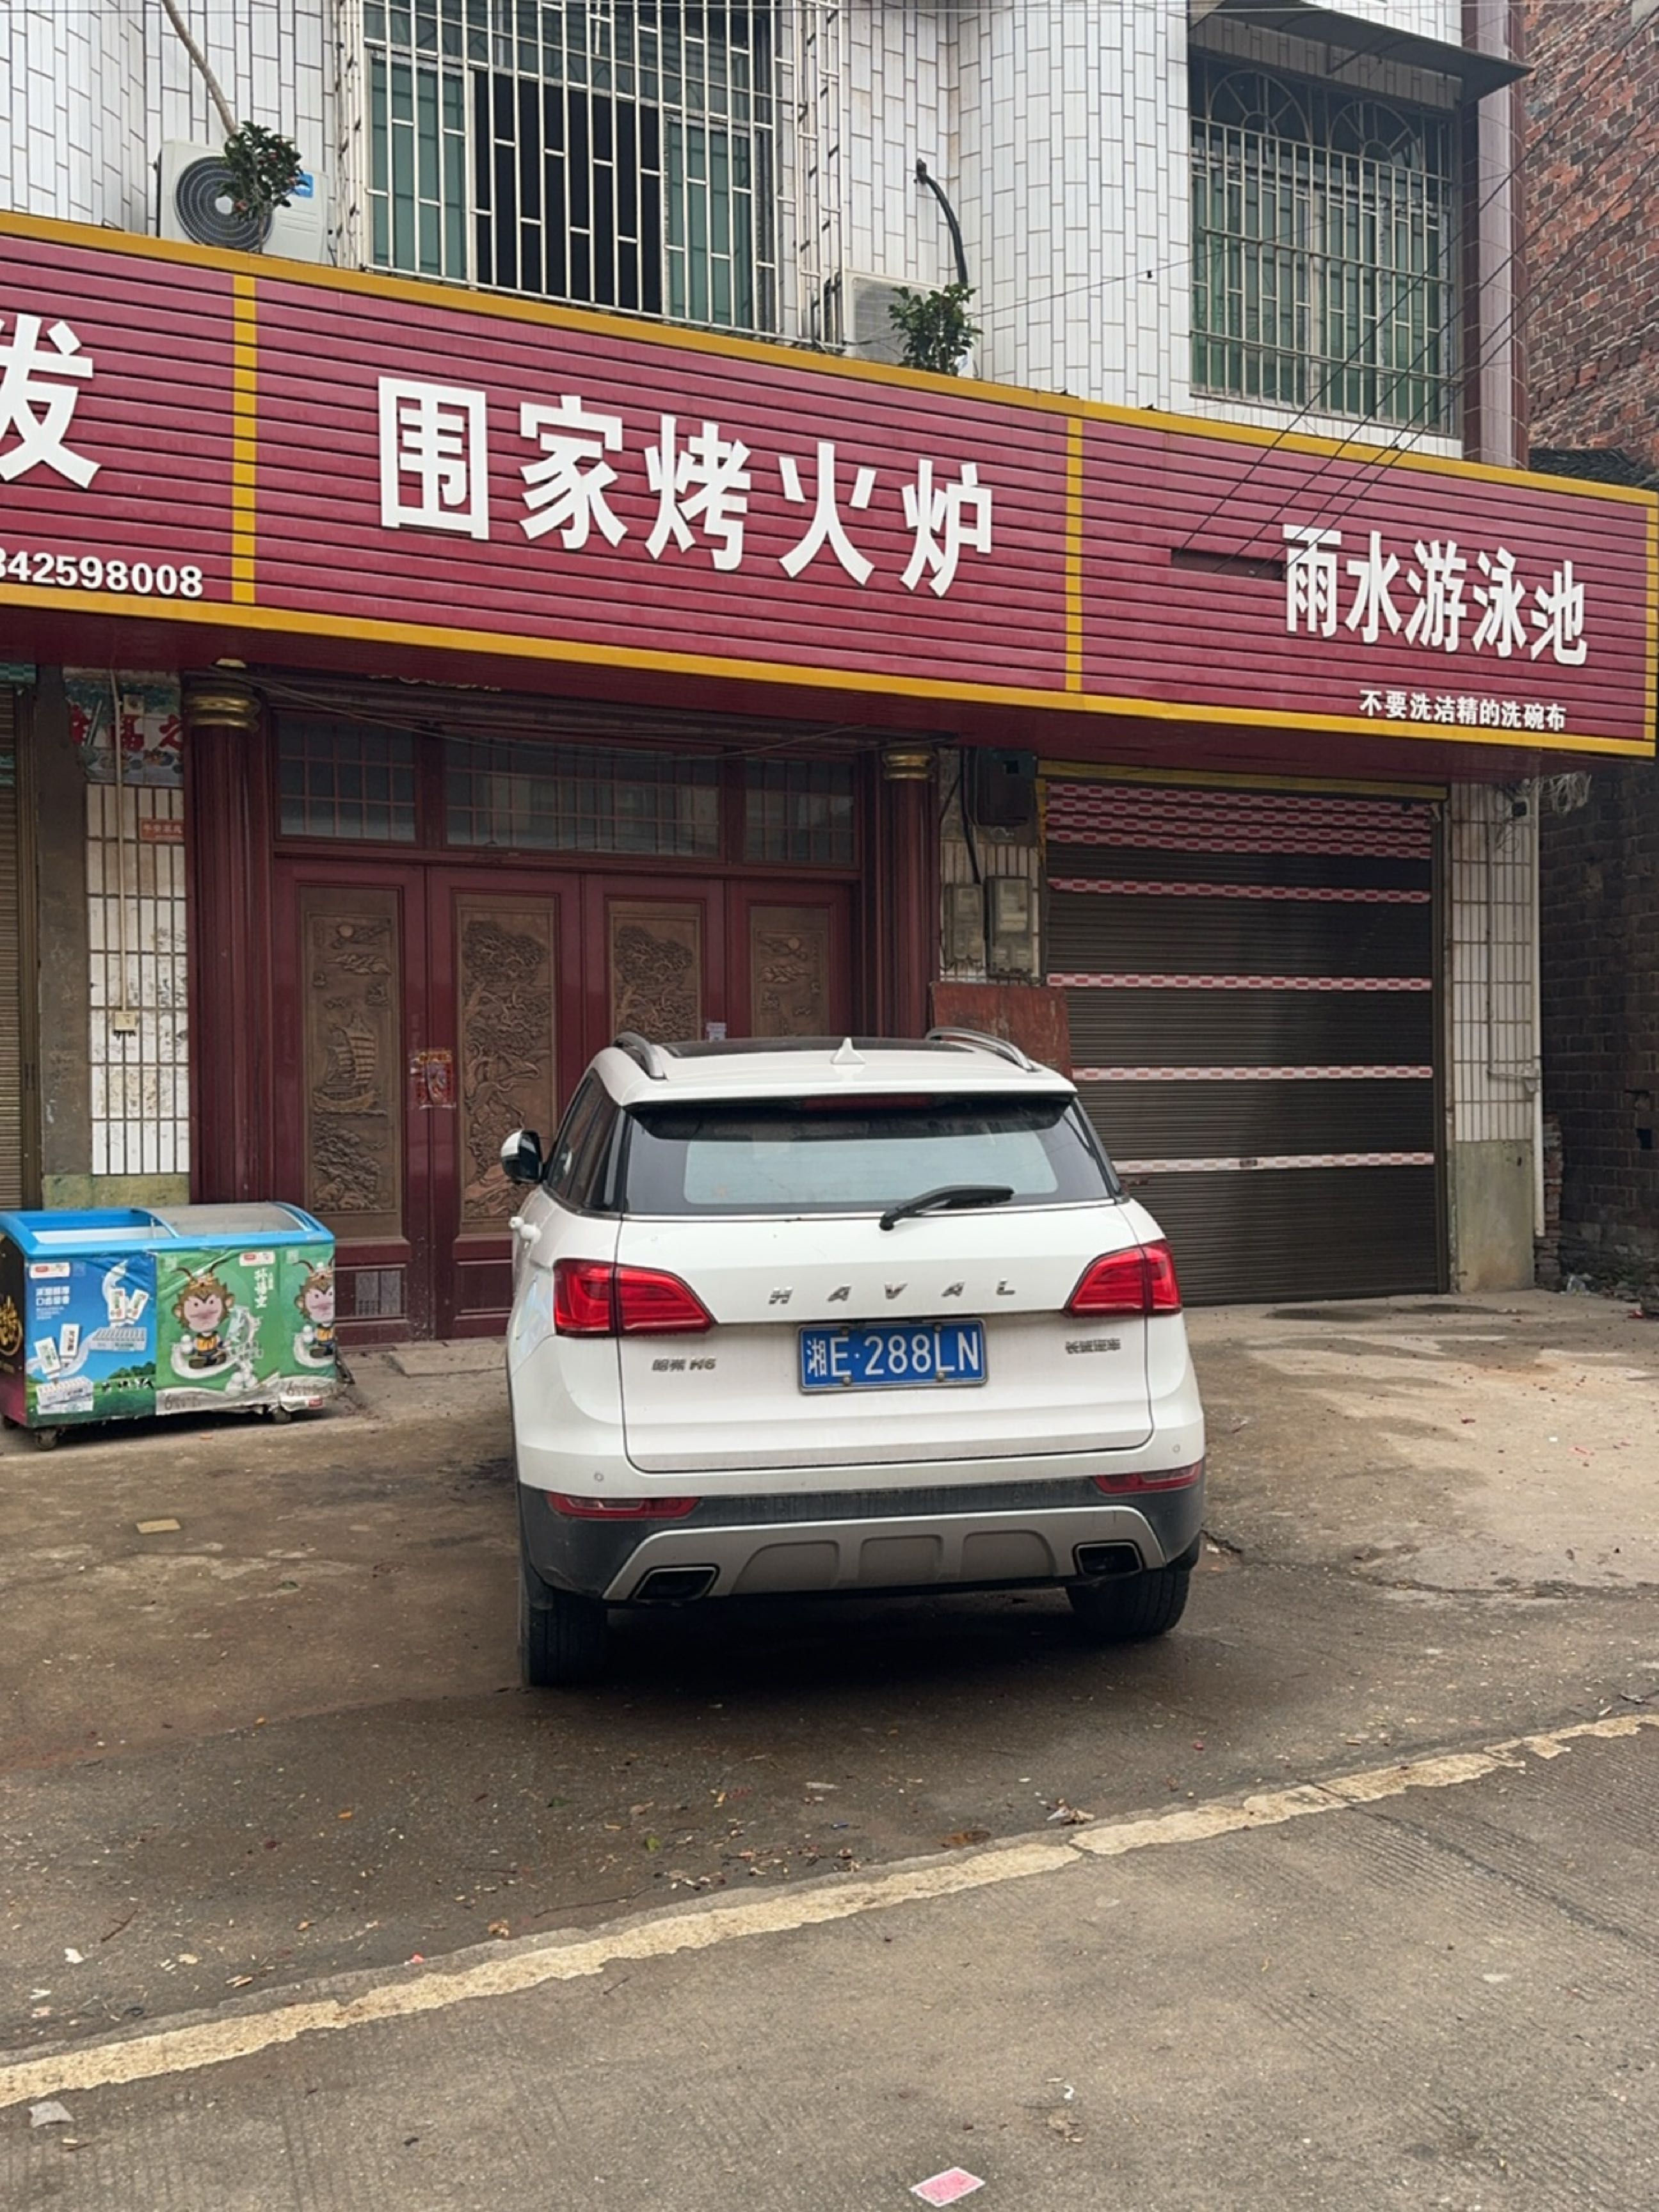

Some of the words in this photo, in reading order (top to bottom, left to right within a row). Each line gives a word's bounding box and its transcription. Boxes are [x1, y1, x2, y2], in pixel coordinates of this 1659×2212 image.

[378, 376, 992, 597] 围家烤火炉
[0, 547, 203, 598] 42598008
[1283, 524, 1587, 665] 雨水游泳池
[1359, 689, 1566, 731] 不要洗洁精的洗碗布
[769, 1279, 1016, 1305] HAVAL
